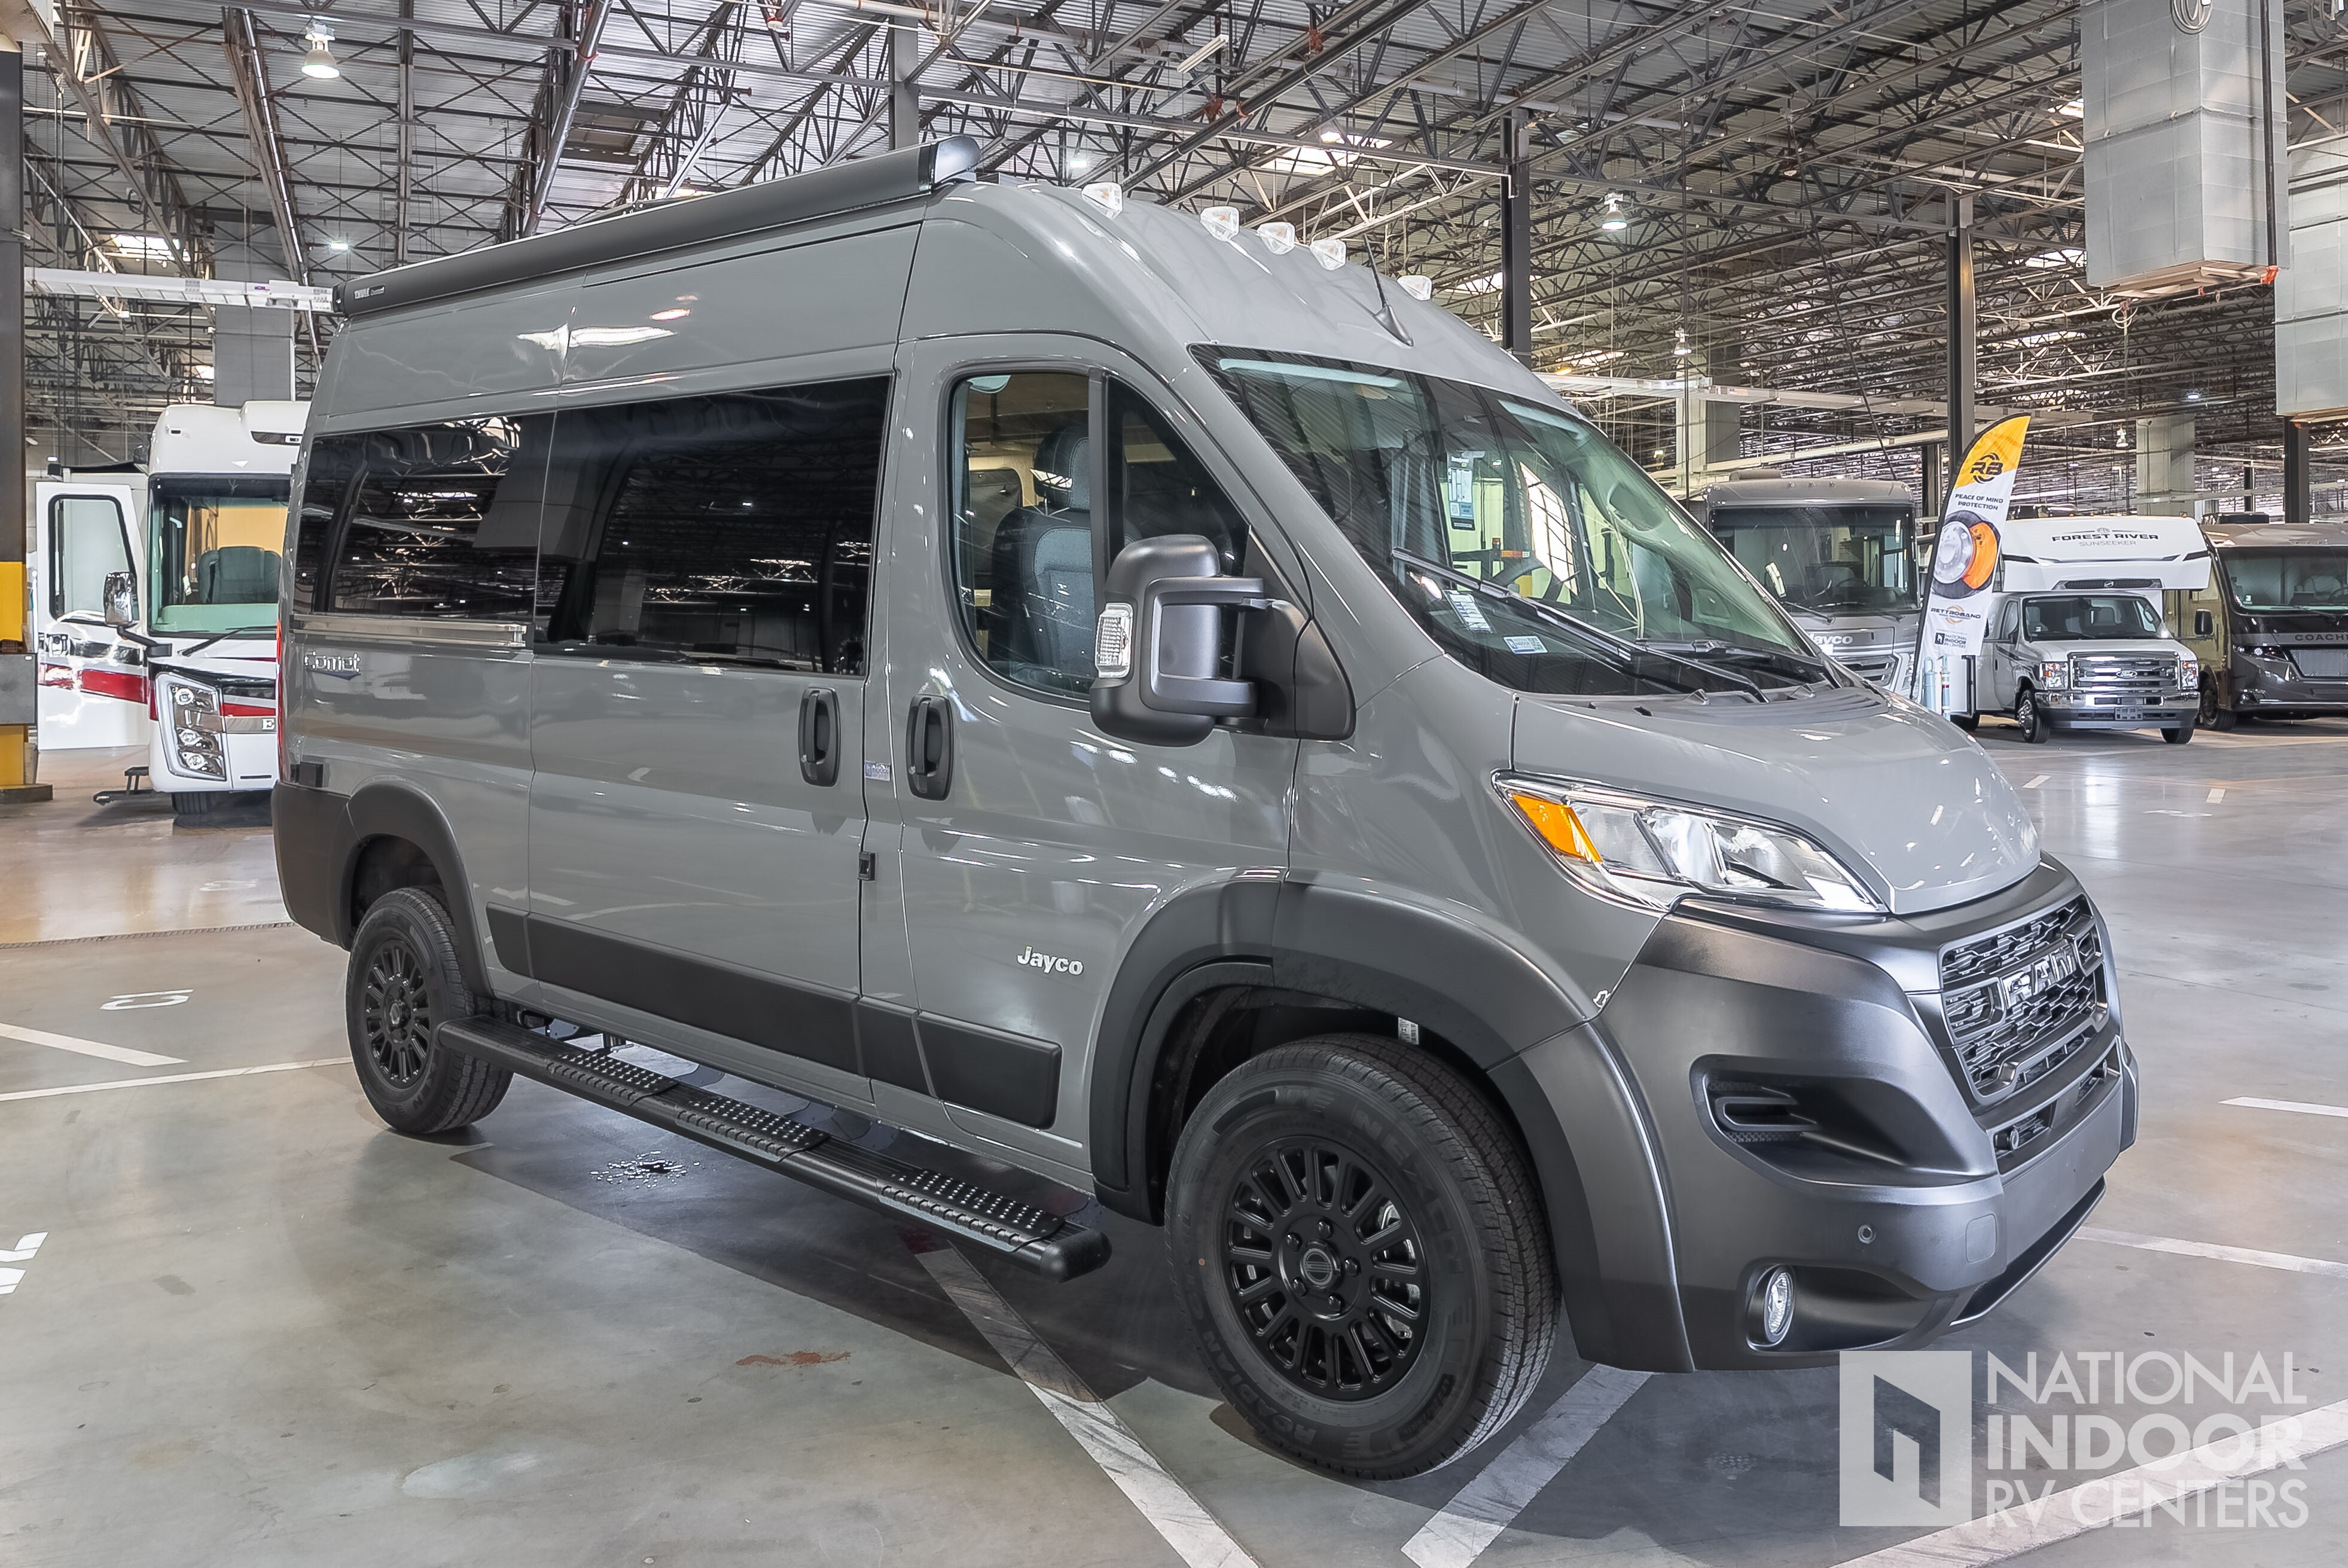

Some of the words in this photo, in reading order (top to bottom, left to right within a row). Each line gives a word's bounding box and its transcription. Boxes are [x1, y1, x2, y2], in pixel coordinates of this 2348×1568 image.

[1957, 501, 1998, 511] PROTECTION
[1931, 608, 1981, 619] RETTROBAND
[304, 651, 361, 672] Comet
[1017, 946, 1084, 975] Jayco
[2001, 944, 2077, 1009] RAM
[1351, 1108, 1465, 1274] NEXEN
[1200, 1329, 1317, 1445] ROADIAN
